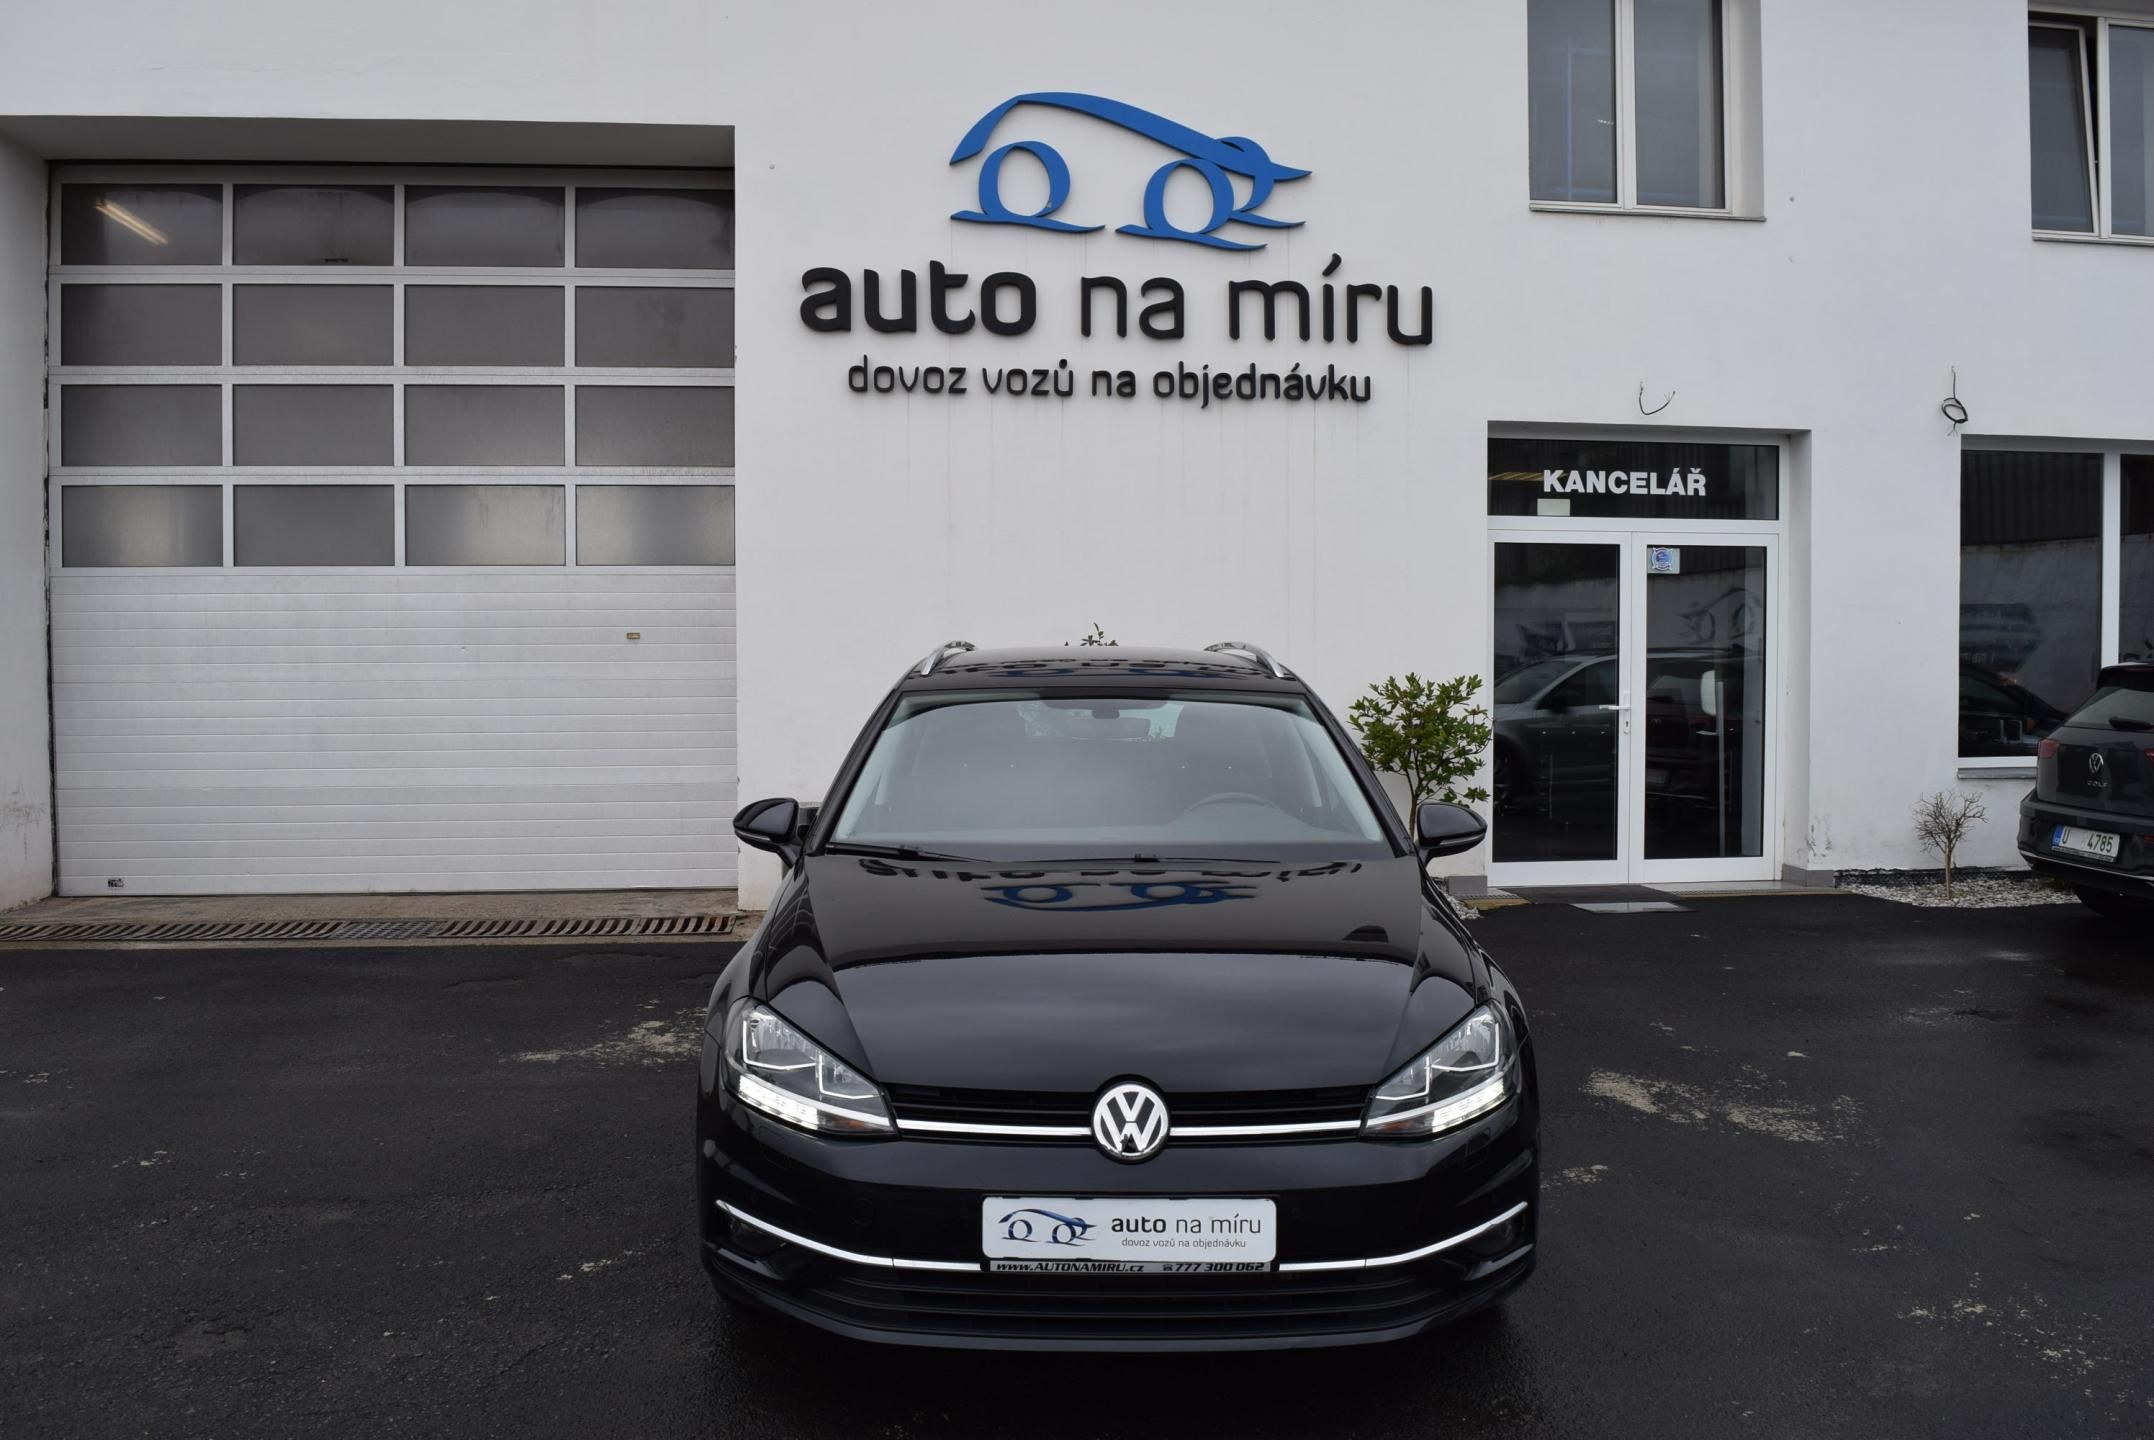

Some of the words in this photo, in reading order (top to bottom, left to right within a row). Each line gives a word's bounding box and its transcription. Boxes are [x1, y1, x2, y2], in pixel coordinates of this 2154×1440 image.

[800, 260, 1037, 336] auto
[1081, 275, 1185, 339] na
[1229, 253, 1434, 346] míru
[848, 355, 967, 396] dovoz
[982, 358, 1074, 397] vozů
[1091, 369, 1136, 398] na
[1153, 361, 1372, 409] objednávku
[1543, 467, 1707, 496] KANCELÁŘ
[1111, 1216, 1167, 1233] auto
[1176, 1218, 1202, 1234] na
[1211, 1213, 1262, 1234] míru
[1121, 1238, 1150, 1247] dovoz
[1153, 1238, 1176, 1248] vozů
[1178, 1239, 1190, 1248] na
[1192, 1238, 1247, 1250] objednávku
[1204, 1263, 1233, 1272] 300
